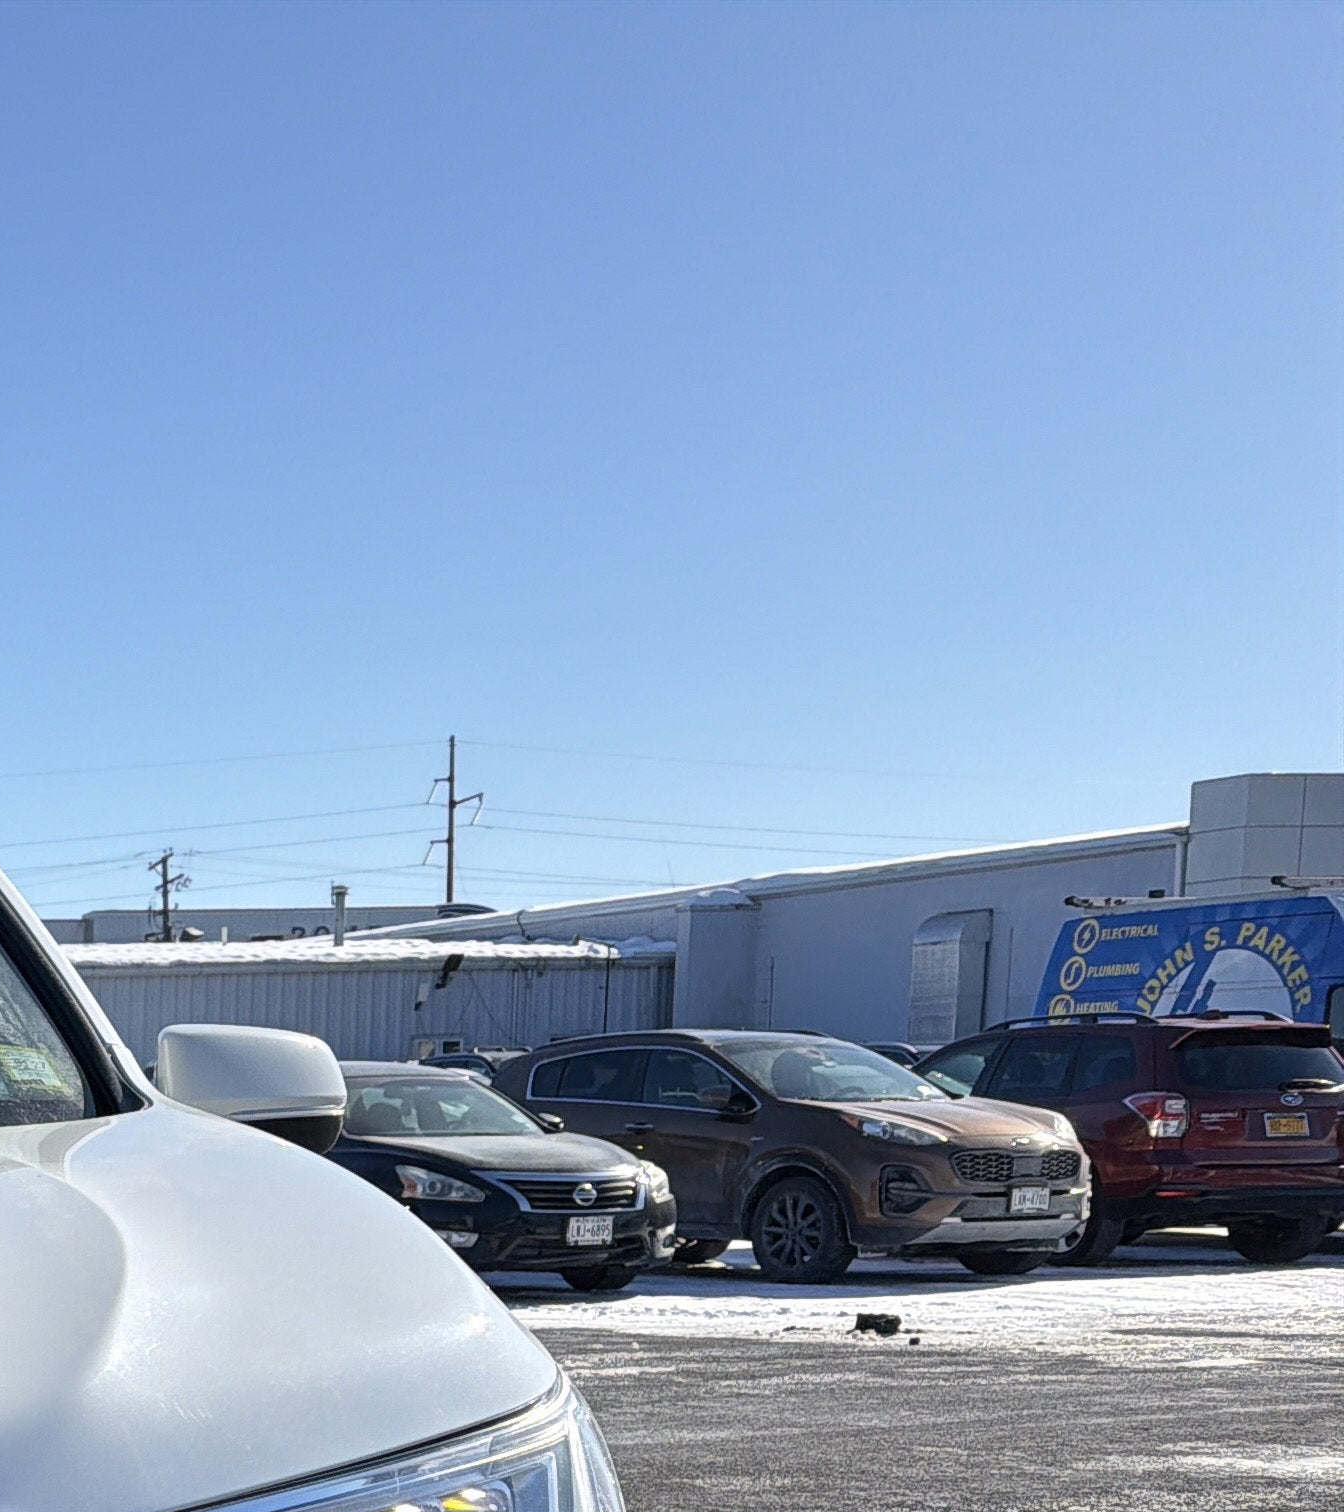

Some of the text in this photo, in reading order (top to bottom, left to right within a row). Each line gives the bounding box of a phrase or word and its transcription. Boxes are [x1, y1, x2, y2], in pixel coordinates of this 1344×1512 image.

[1100, 924, 1159, 941] ELECTRICAL
[1087, 963, 1141, 978] PLUMBING
[1136, 922, 1312, 1016] JOHN S. PARKER
[1076, 1000, 1119, 1014] HEATING
